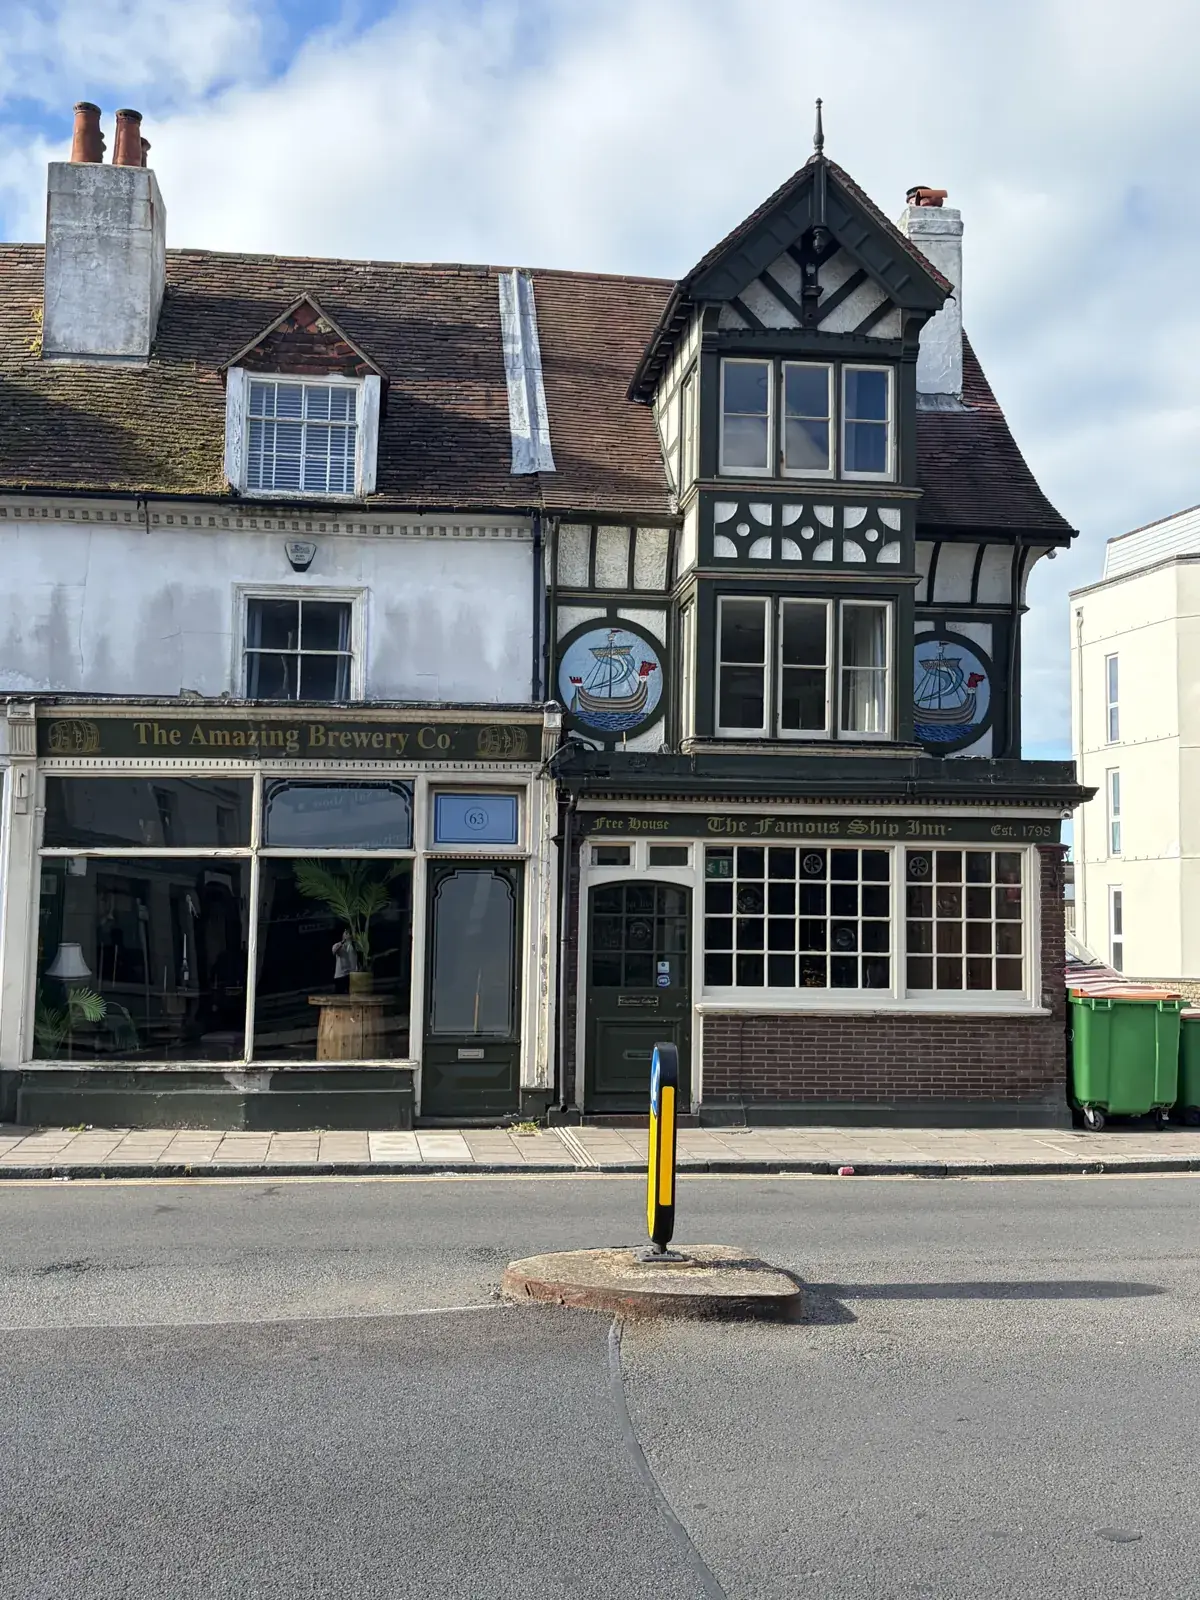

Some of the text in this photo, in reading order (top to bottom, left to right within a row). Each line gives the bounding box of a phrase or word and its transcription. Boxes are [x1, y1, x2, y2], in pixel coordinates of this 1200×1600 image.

[133, 722, 456, 754] The Amazing Brewery Co.
[469, 812, 484, 825] 63
[591, 816, 670, 831] Free House
[707, 816, 747, 833] The
[751, 817, 840, 836] Famous
[846, 819, 900, 836] Ship
[990, 824, 1051, 837] Est. 1798
